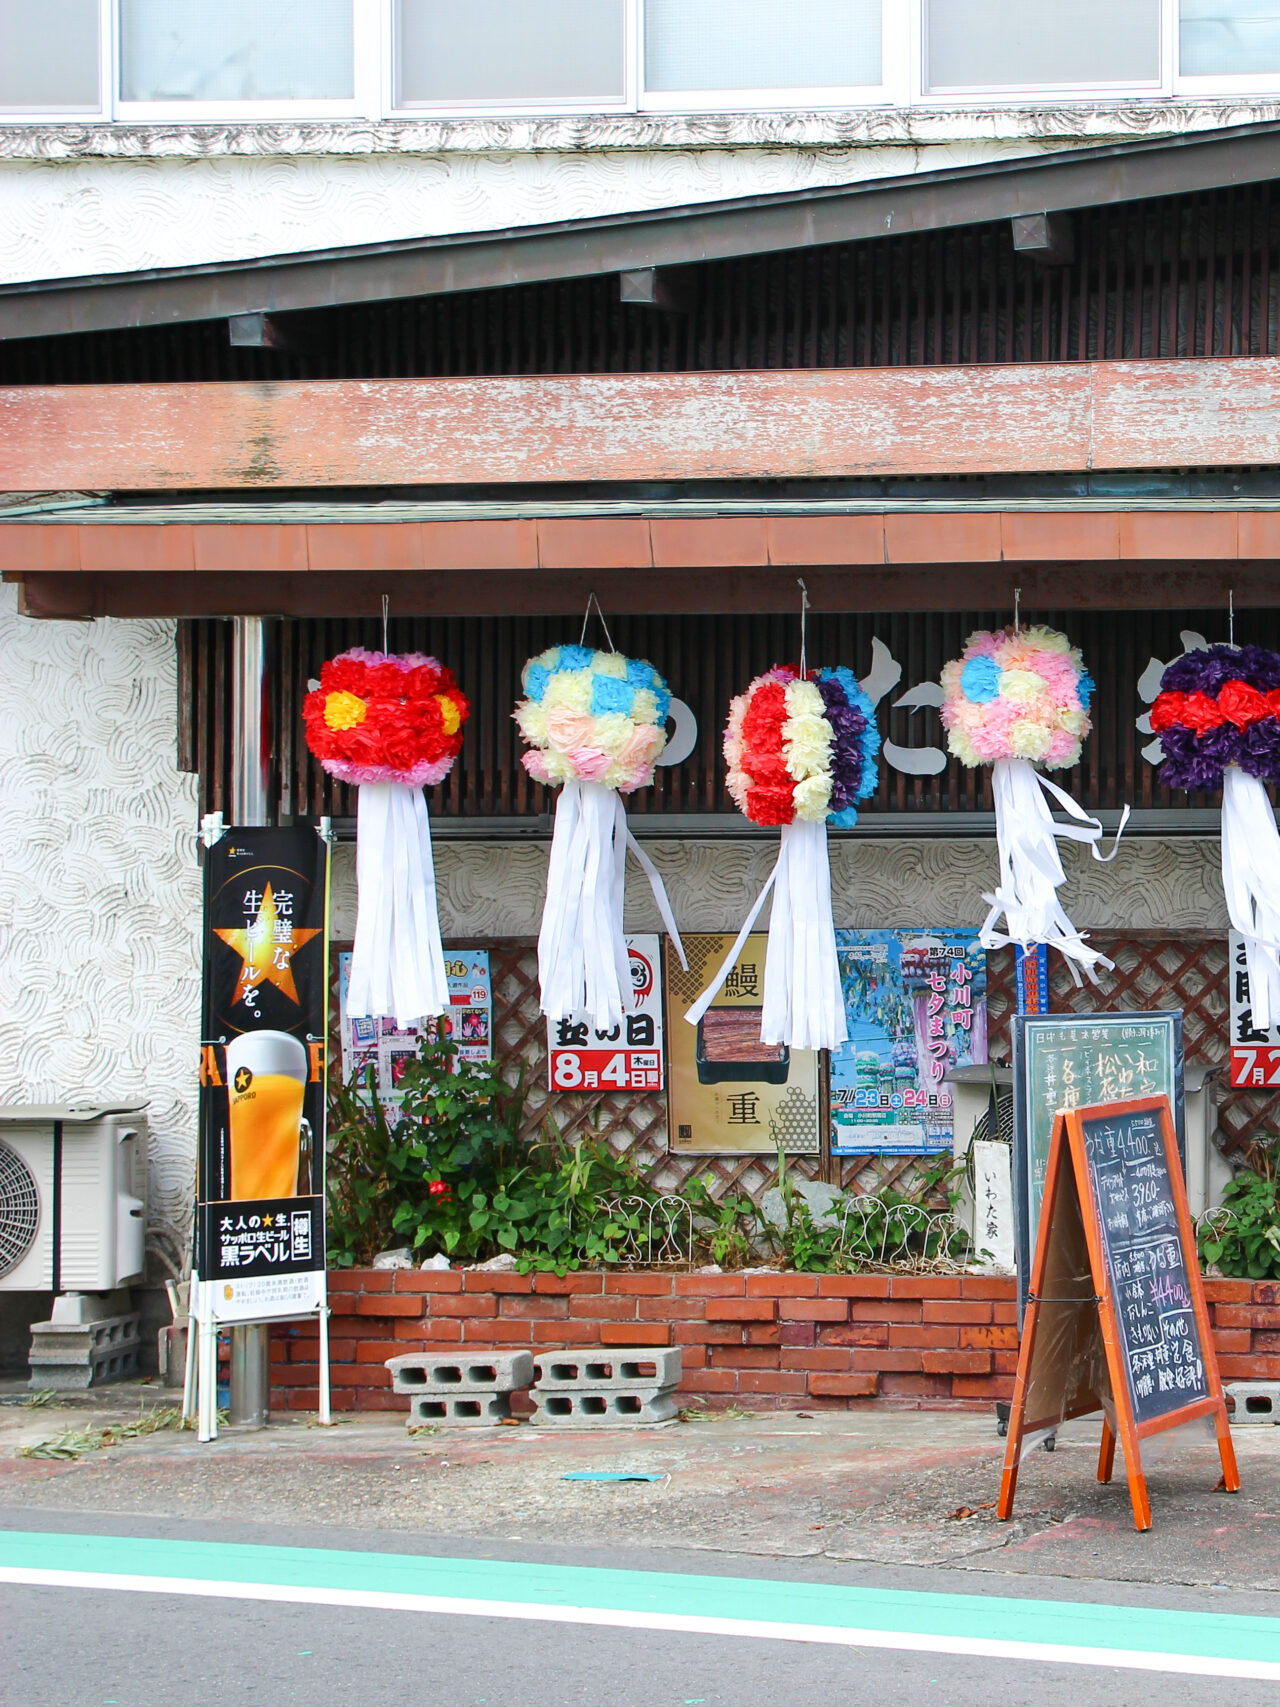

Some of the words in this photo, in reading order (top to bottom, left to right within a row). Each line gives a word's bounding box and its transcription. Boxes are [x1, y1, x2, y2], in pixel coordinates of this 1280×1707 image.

[271, 889, 294, 970] 完璧な
[242, 889, 264, 1018] 生ビールを。
[929, 946, 965, 957] 第74回
[473, 991, 486, 999] 119
[724, 963, 759, 998] 鰻
[951, 963, 972, 1030] 小川町
[925, 972, 947, 1082] 七夕まつり
[554, 1053, 646, 1088] 8月4日
[633, 1056, 655, 1066] 木曜日
[232, 1091, 256, 1105] SAPPORO
[727, 1091, 761, 1125] 重
[984, 1171, 999, 1239] いわた家
[220, 1229, 290, 1245] サッポロ生ビール
[220, 1242, 290, 1267] 黒ラベル
